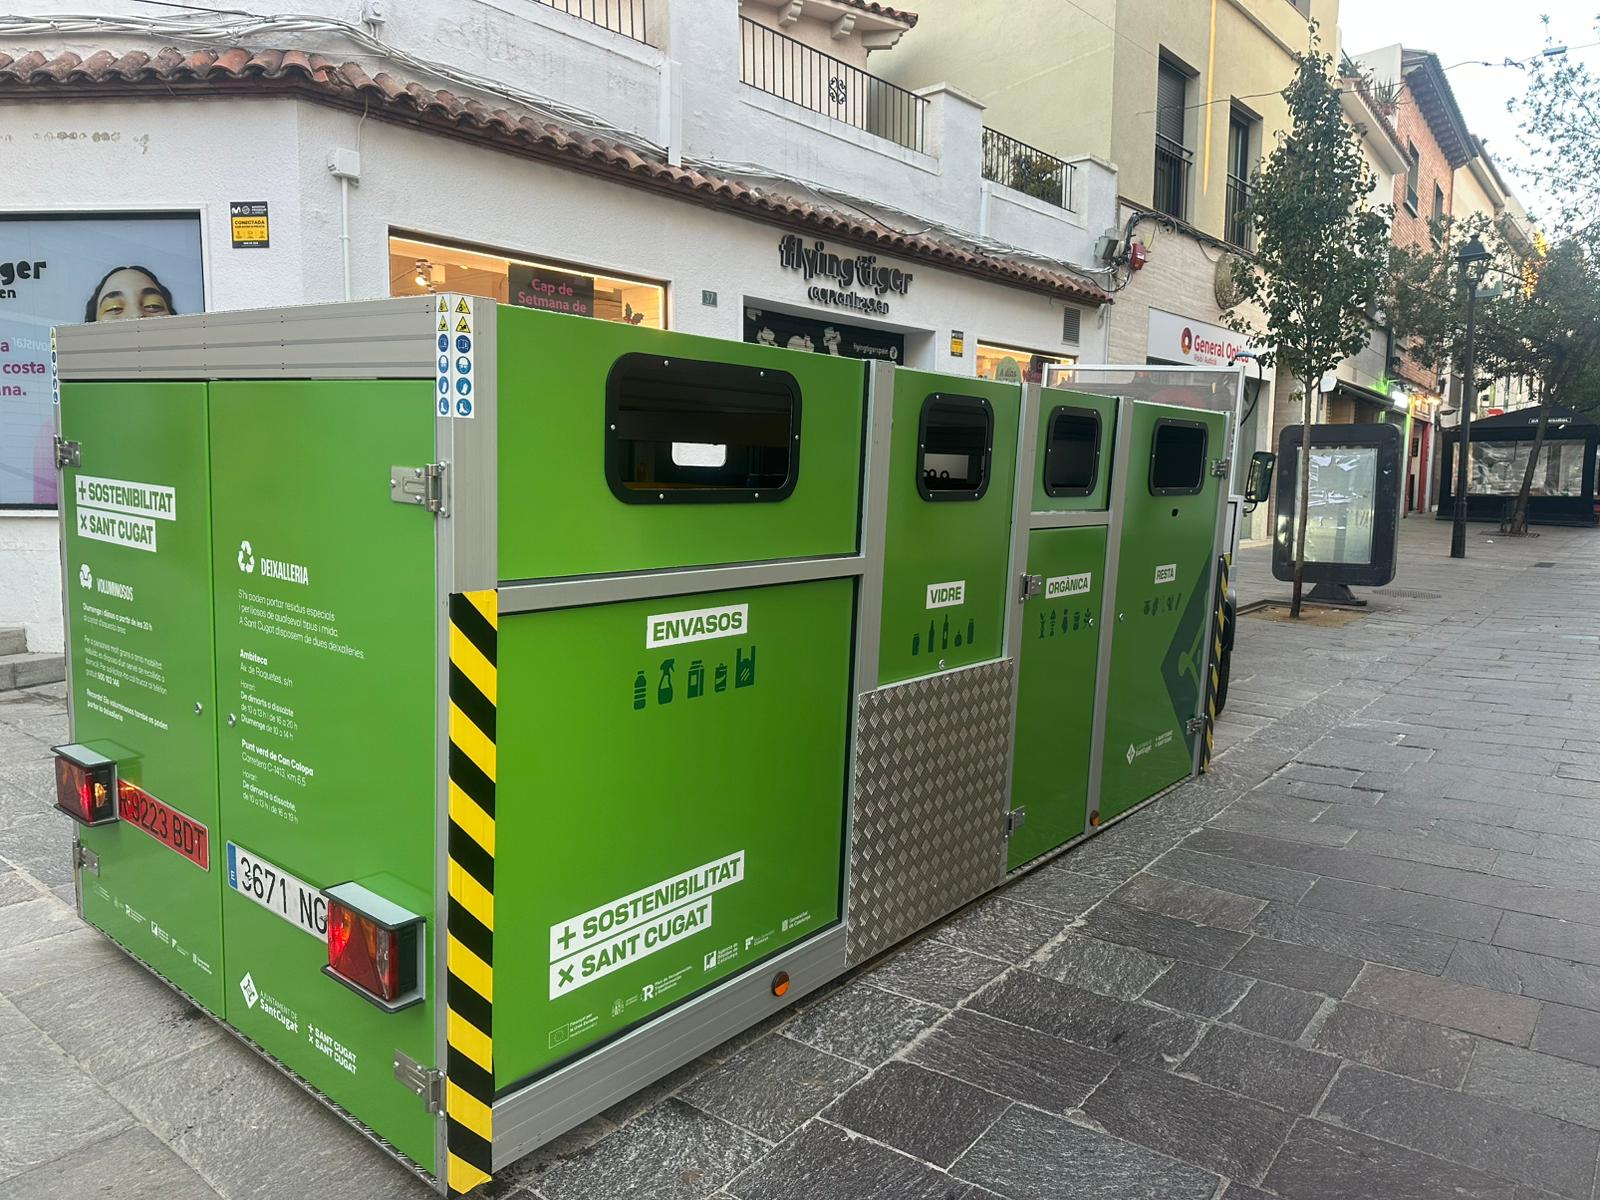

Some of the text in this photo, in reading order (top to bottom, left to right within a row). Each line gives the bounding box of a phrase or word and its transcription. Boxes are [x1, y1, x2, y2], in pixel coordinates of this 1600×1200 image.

[531, 278, 574, 297] Cap de
[855, 255, 913, 295] tiger
[518, 291, 587, 313] Setmana de
[704, 292, 715, 302] 37
[808, 286, 890, 314] copenhagen
[0, 342, 10, 352] a
[1194, 335, 1225, 358] General
[3, 362, 46, 374] costa
[89, 483, 173, 512] SOSTENIBILITAT
[90, 515, 116, 537] SANT
[118, 520, 153, 544] CUGAT
[260, 558, 309, 585] DEIXALLERIA
[1048, 576, 1088, 594] ORGÀNICA
[1156, 568, 1174, 580] RESTA
[286, 601, 306, 614] residus
[930, 586, 962, 603] VIDRE
[244, 618, 257, 629] Sant
[258, 621, 275, 635] Cugat
[652, 611, 742, 642] ENVASOS
[240, 649, 268, 665] Ambiteca
[242, 739, 314, 777] Punt verd de Can Calopa
[131, 793, 168, 839] 9223
[172, 814, 205, 861] BDT
[240, 857, 288, 914] 3671
[582, 856, 742, 939] SOSTENIBILITAT
[581, 938, 639, 978] SANT
[643, 902, 709, 949] CUGAT
[260, 999, 298, 1033] SantCugat
[315, 1028, 333, 1047] SANT
[334, 1041, 357, 1063] CUGAT
[315, 1039, 333, 1058] SANT
[334, 1052, 357, 1075] CUGAT
